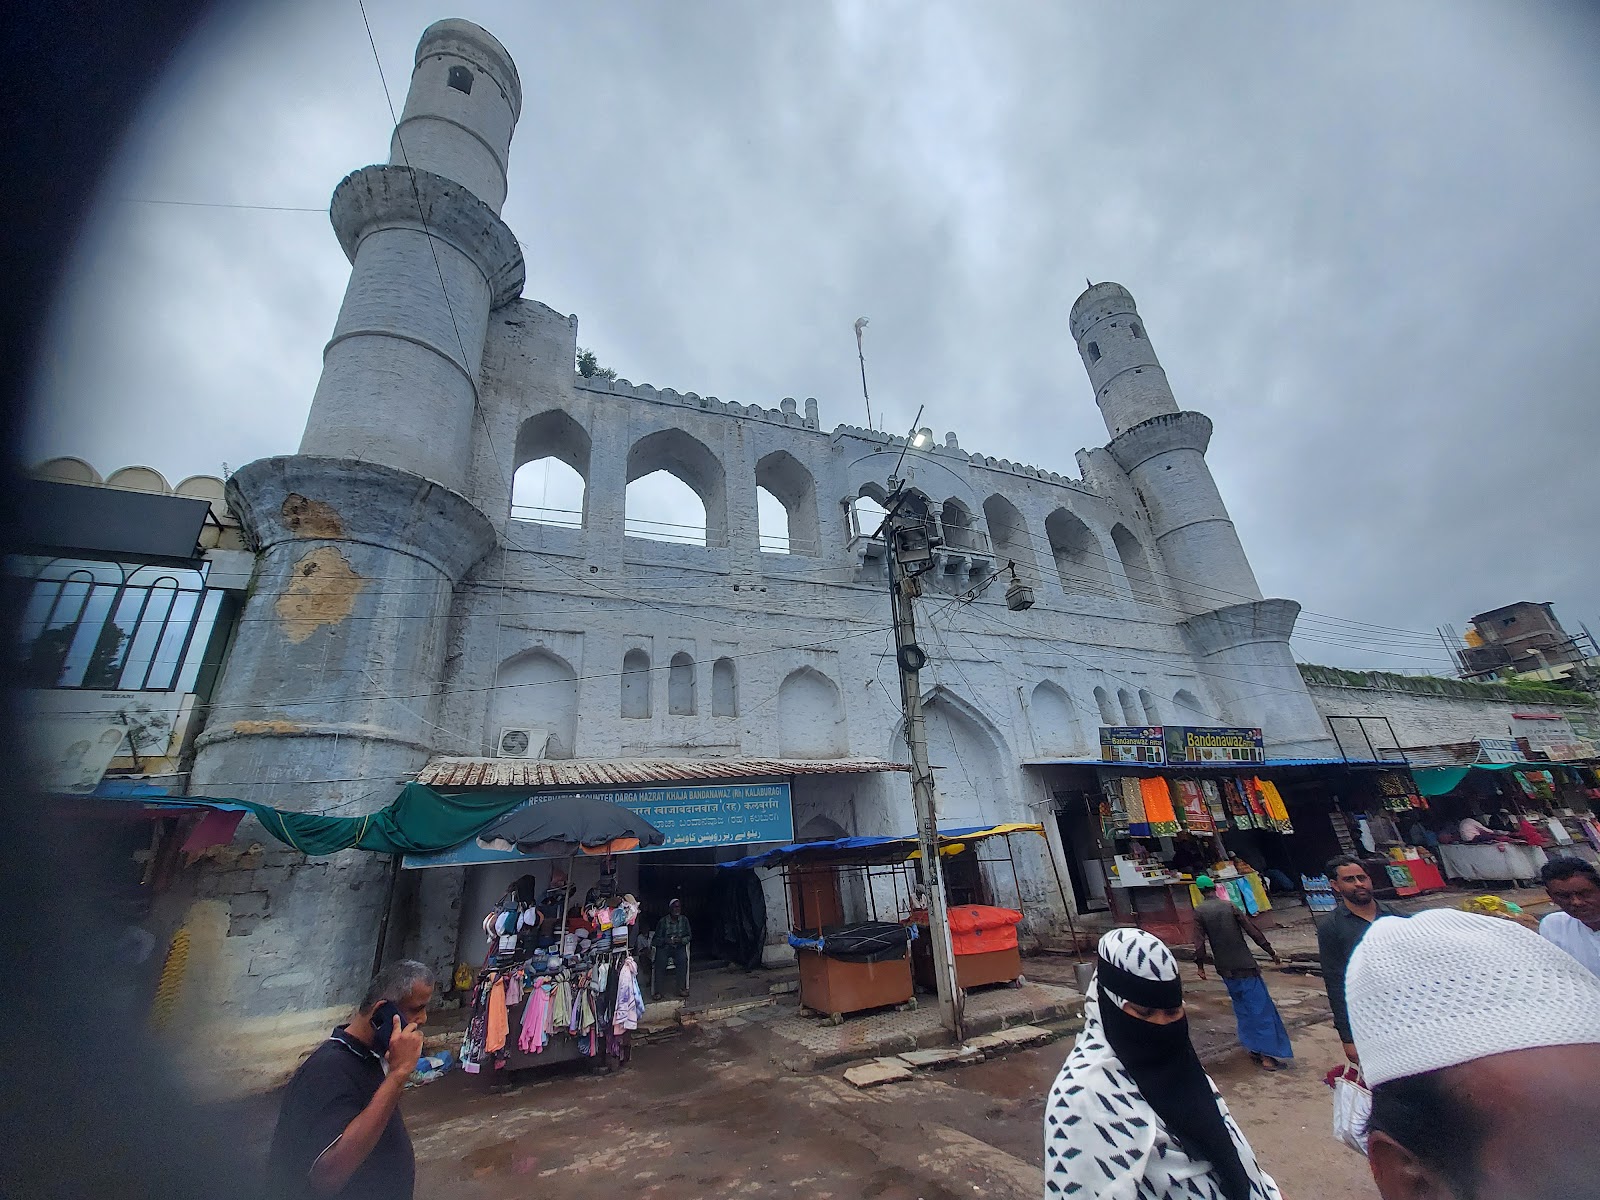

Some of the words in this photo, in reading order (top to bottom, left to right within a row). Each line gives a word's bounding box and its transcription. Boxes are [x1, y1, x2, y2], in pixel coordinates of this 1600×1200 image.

[1186, 732, 1244, 747] Bandanawaz
[614, 792, 638, 803] DARGA
[638, 791, 665, 802] HAZRAT
[666, 790, 688, 801] KHAJA
[689, 789, 731, 800] BANDANAWAZ
[745, 787, 782, 798] KALABURAGI
